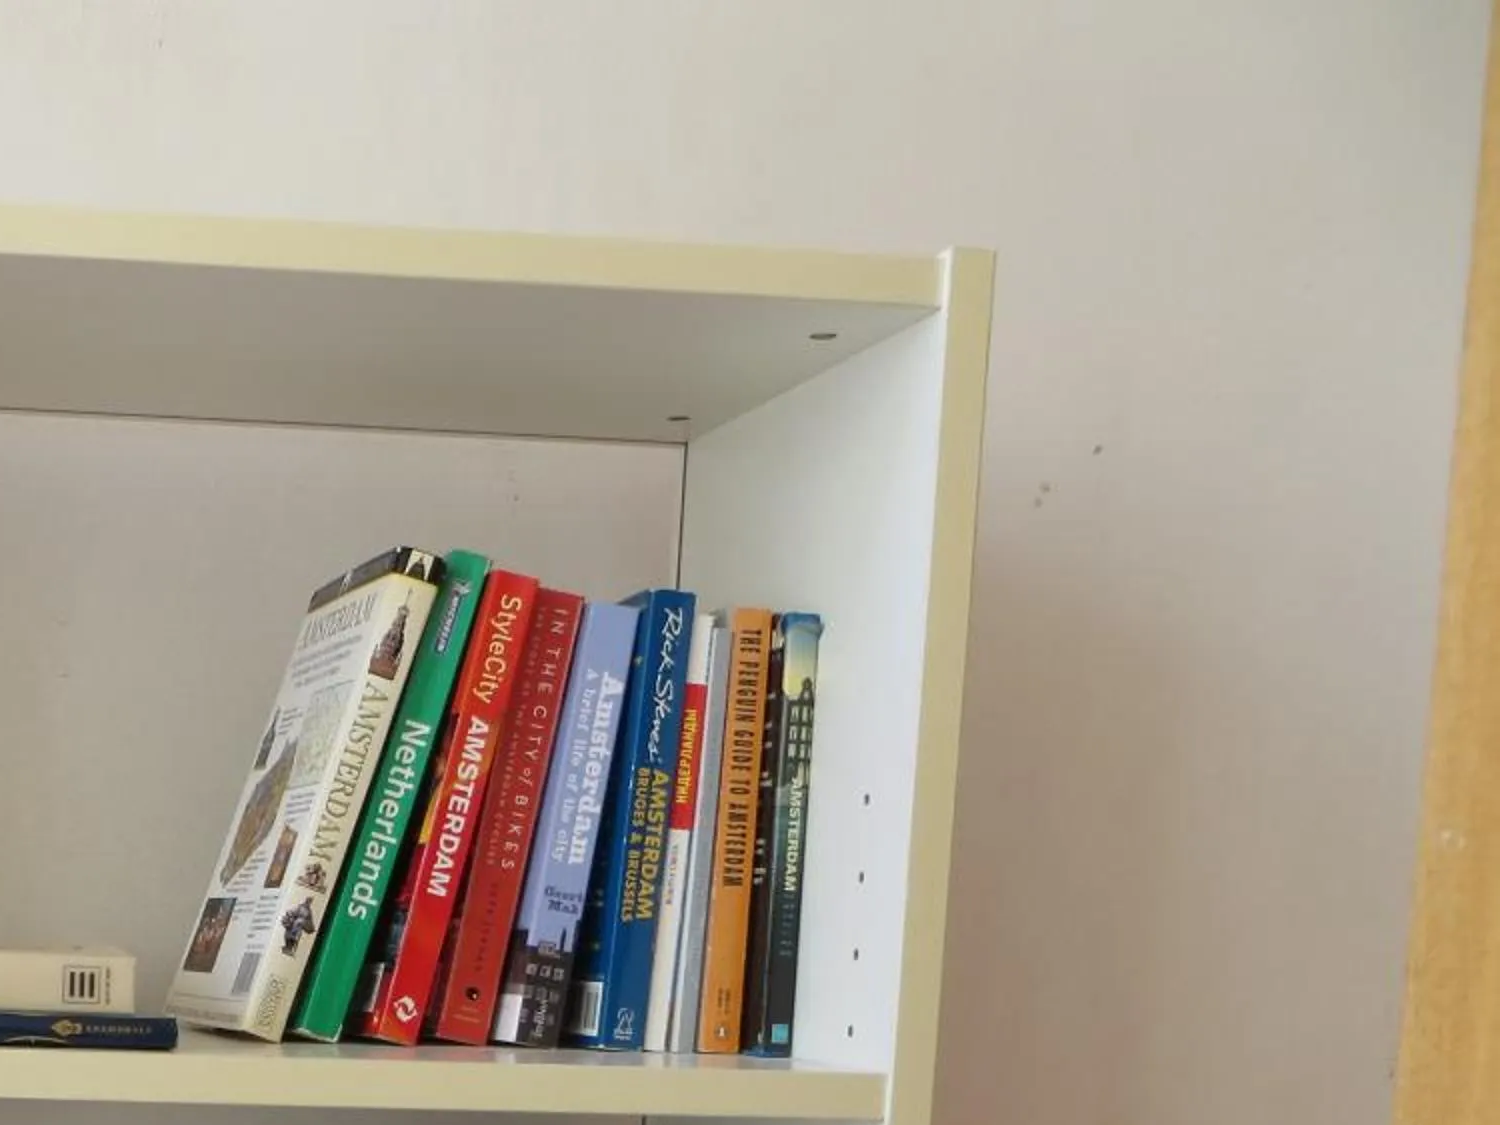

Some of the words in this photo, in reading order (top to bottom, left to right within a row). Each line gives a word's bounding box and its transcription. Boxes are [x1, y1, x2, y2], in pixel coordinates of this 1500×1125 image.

[473, 593, 522, 704] StyleCity
[551, 609, 569, 635] IN
[658, 607, 683, 677] Rick
[739, 630, 762, 653] THE
[537, 648, 561, 693] THE
[586, 668, 600, 680] A
[735, 661, 759, 723] PENGUIN
[526, 705, 547, 761] CITY
[577, 689, 596, 730] brief
[308, 680, 389, 864] AMSTERDAM
[518, 767, 533, 786] of
[568, 671, 625, 865] Amsterdam
[570, 739, 588, 767] life
[731, 729, 755, 770] GUIDE
[426, 715, 490, 898] AMSTERDAM
[561, 799, 574, 823] the
[565, 774, 578, 792] of
[631, 767, 649, 826] BRUGES
[729, 780, 751, 795] TO
[347, 719, 432, 921] Netherlands
[501, 795, 529, 869] BIKES
[551, 830, 569, 863] city
[629, 832, 642, 845] &
[635, 769, 670, 920] AMSTERDAM
[723, 804, 748, 887] AMSTERDAM
[784, 775, 803, 891] AMSTERDAM
[621, 851, 641, 922] BRUSSELS
